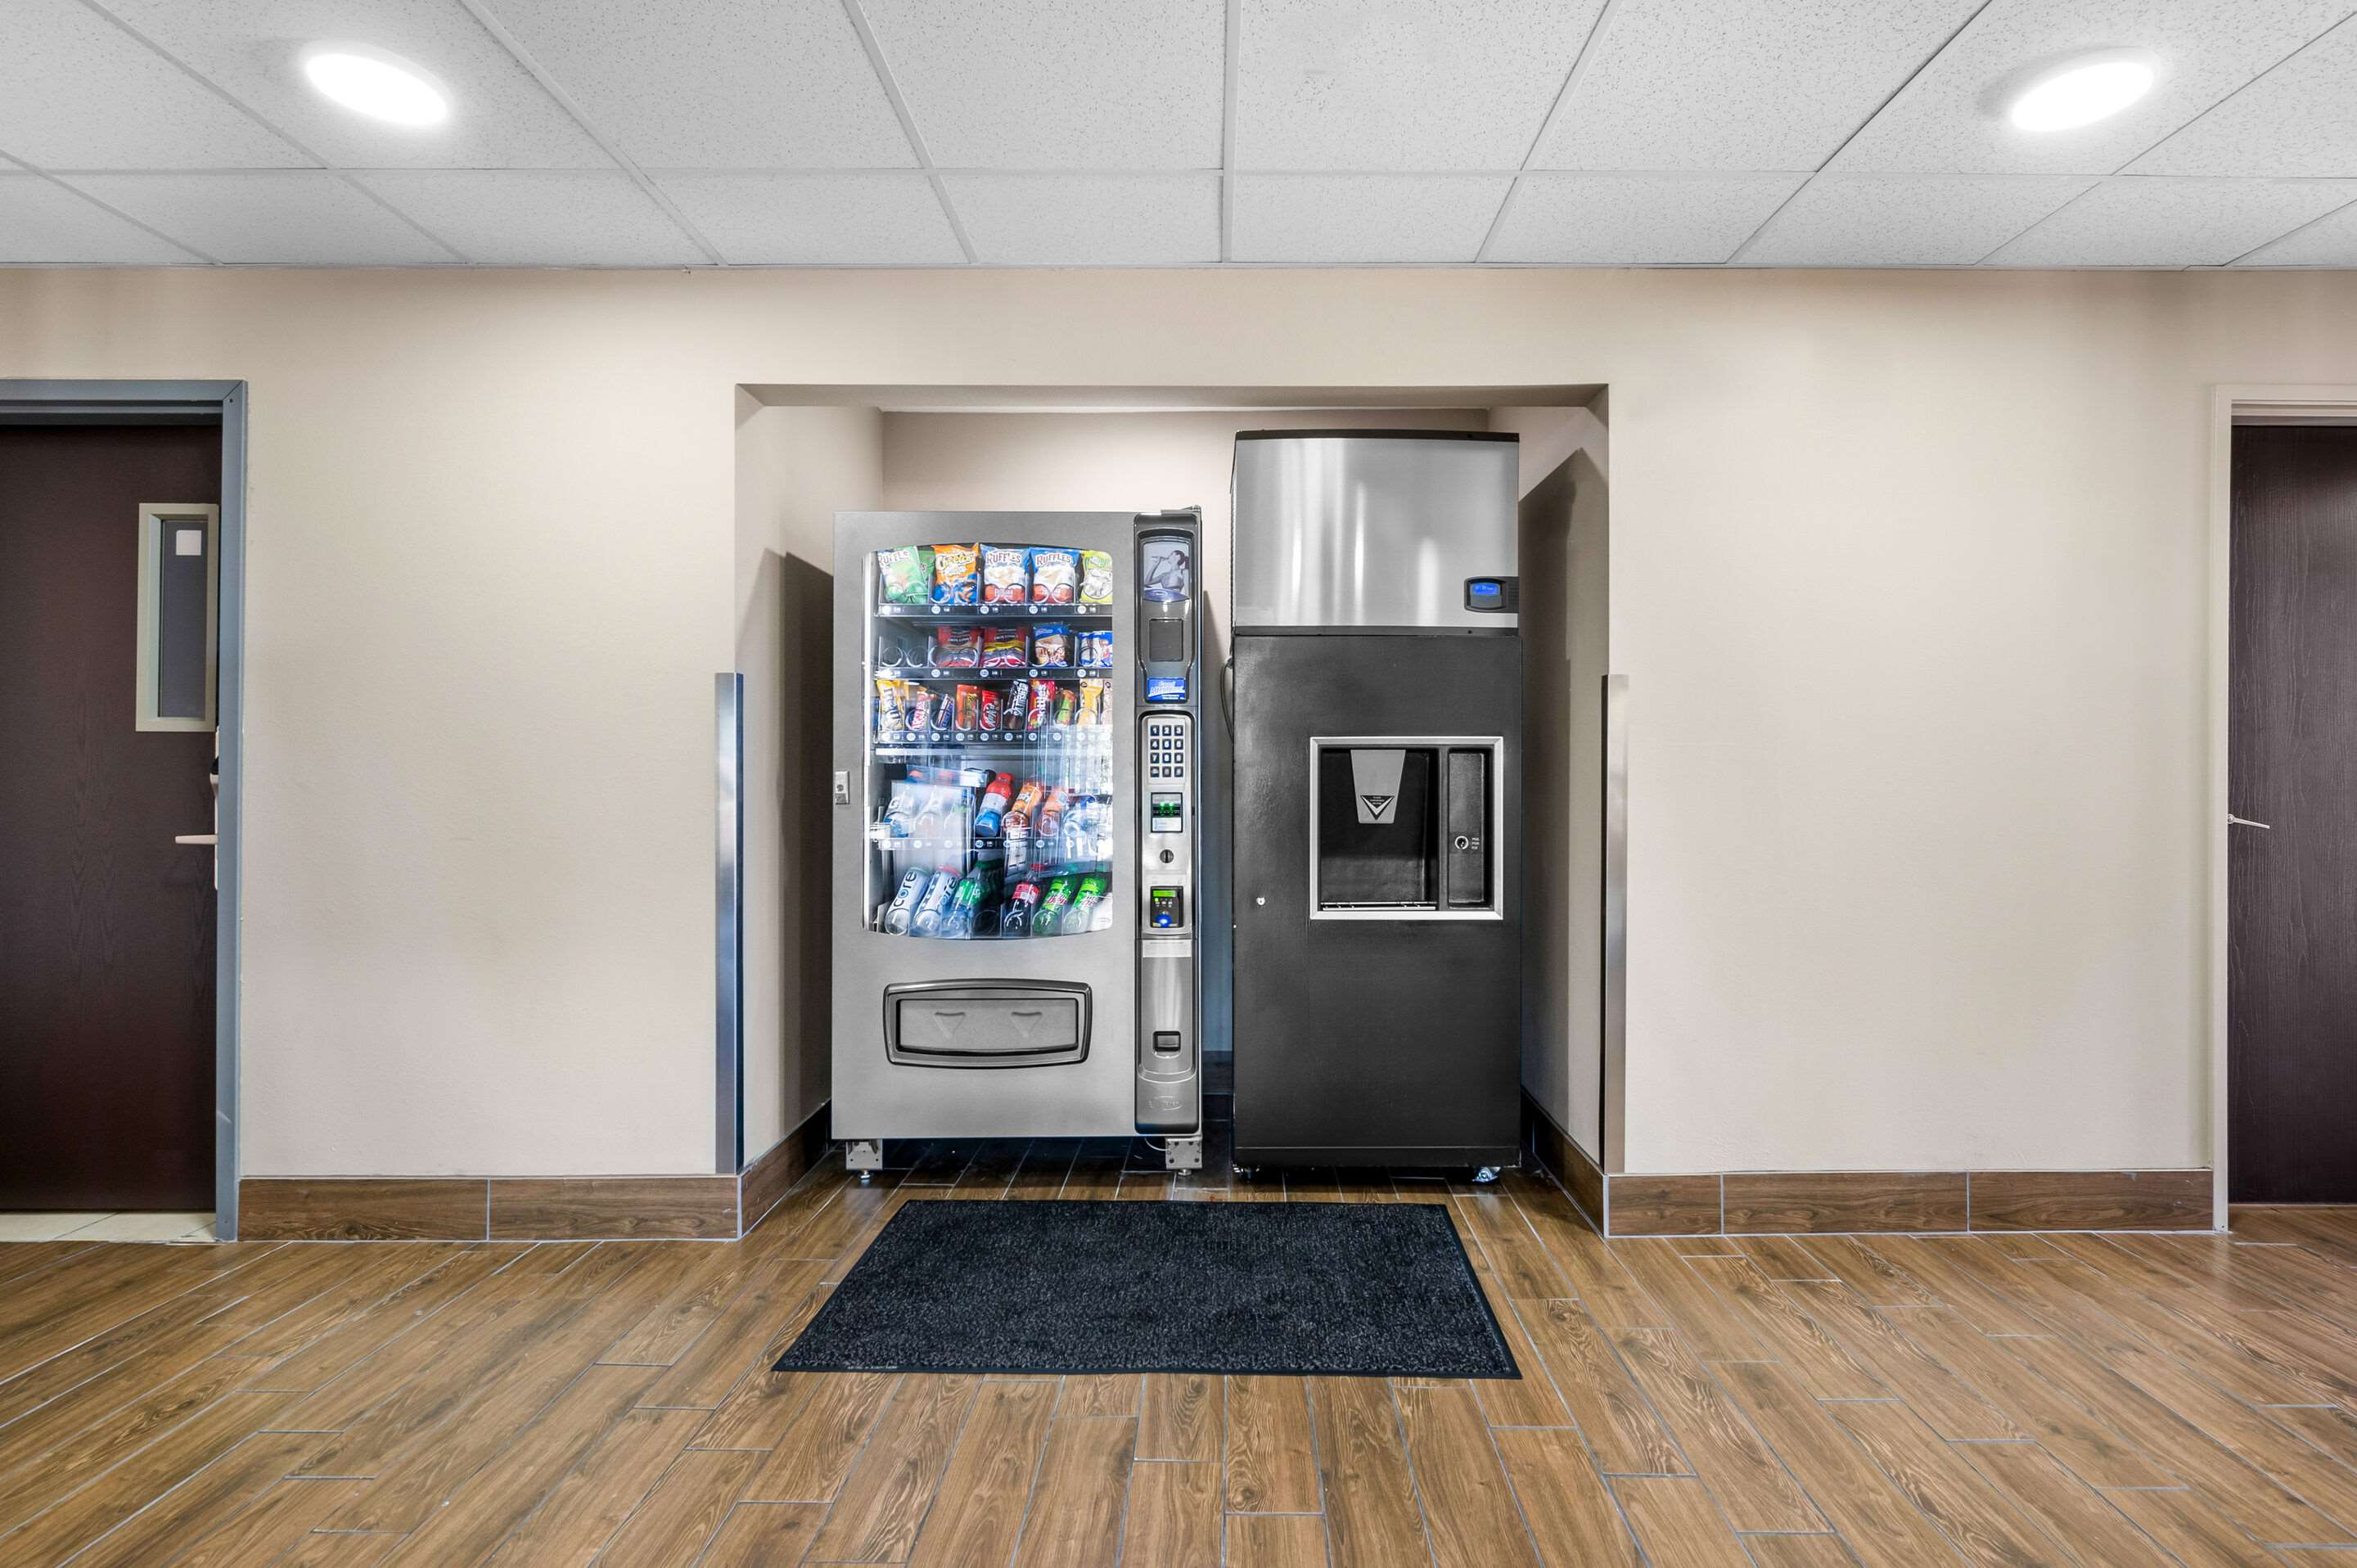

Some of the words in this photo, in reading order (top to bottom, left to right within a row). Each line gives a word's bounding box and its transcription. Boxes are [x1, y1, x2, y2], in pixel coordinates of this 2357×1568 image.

[1036, 553, 1071, 565] RUFFLES
[1151, 740, 1158, 748] 4
[1152, 754, 1158, 762] 7
[1164, 754, 1169, 762] 8
[893, 870, 917, 908] core
